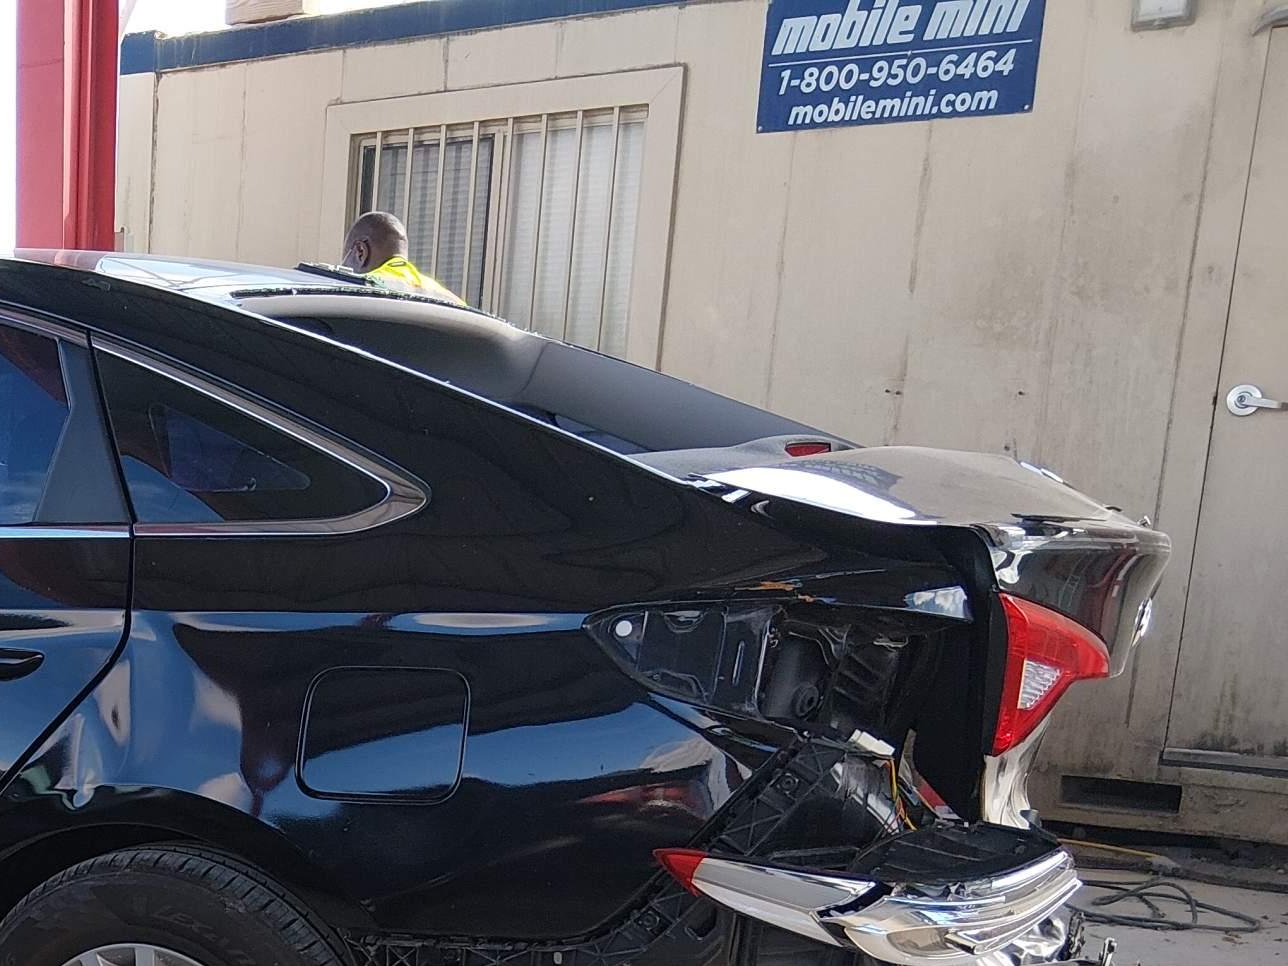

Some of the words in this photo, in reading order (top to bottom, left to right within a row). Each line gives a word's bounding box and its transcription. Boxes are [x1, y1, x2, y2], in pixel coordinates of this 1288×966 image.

[772, 0, 922, 55] mobile
[923, 0, 1031, 41] mini
[779, 49, 1017, 95] 1-800-950-6464
[788, 90, 999, 125] mobilemini.com
